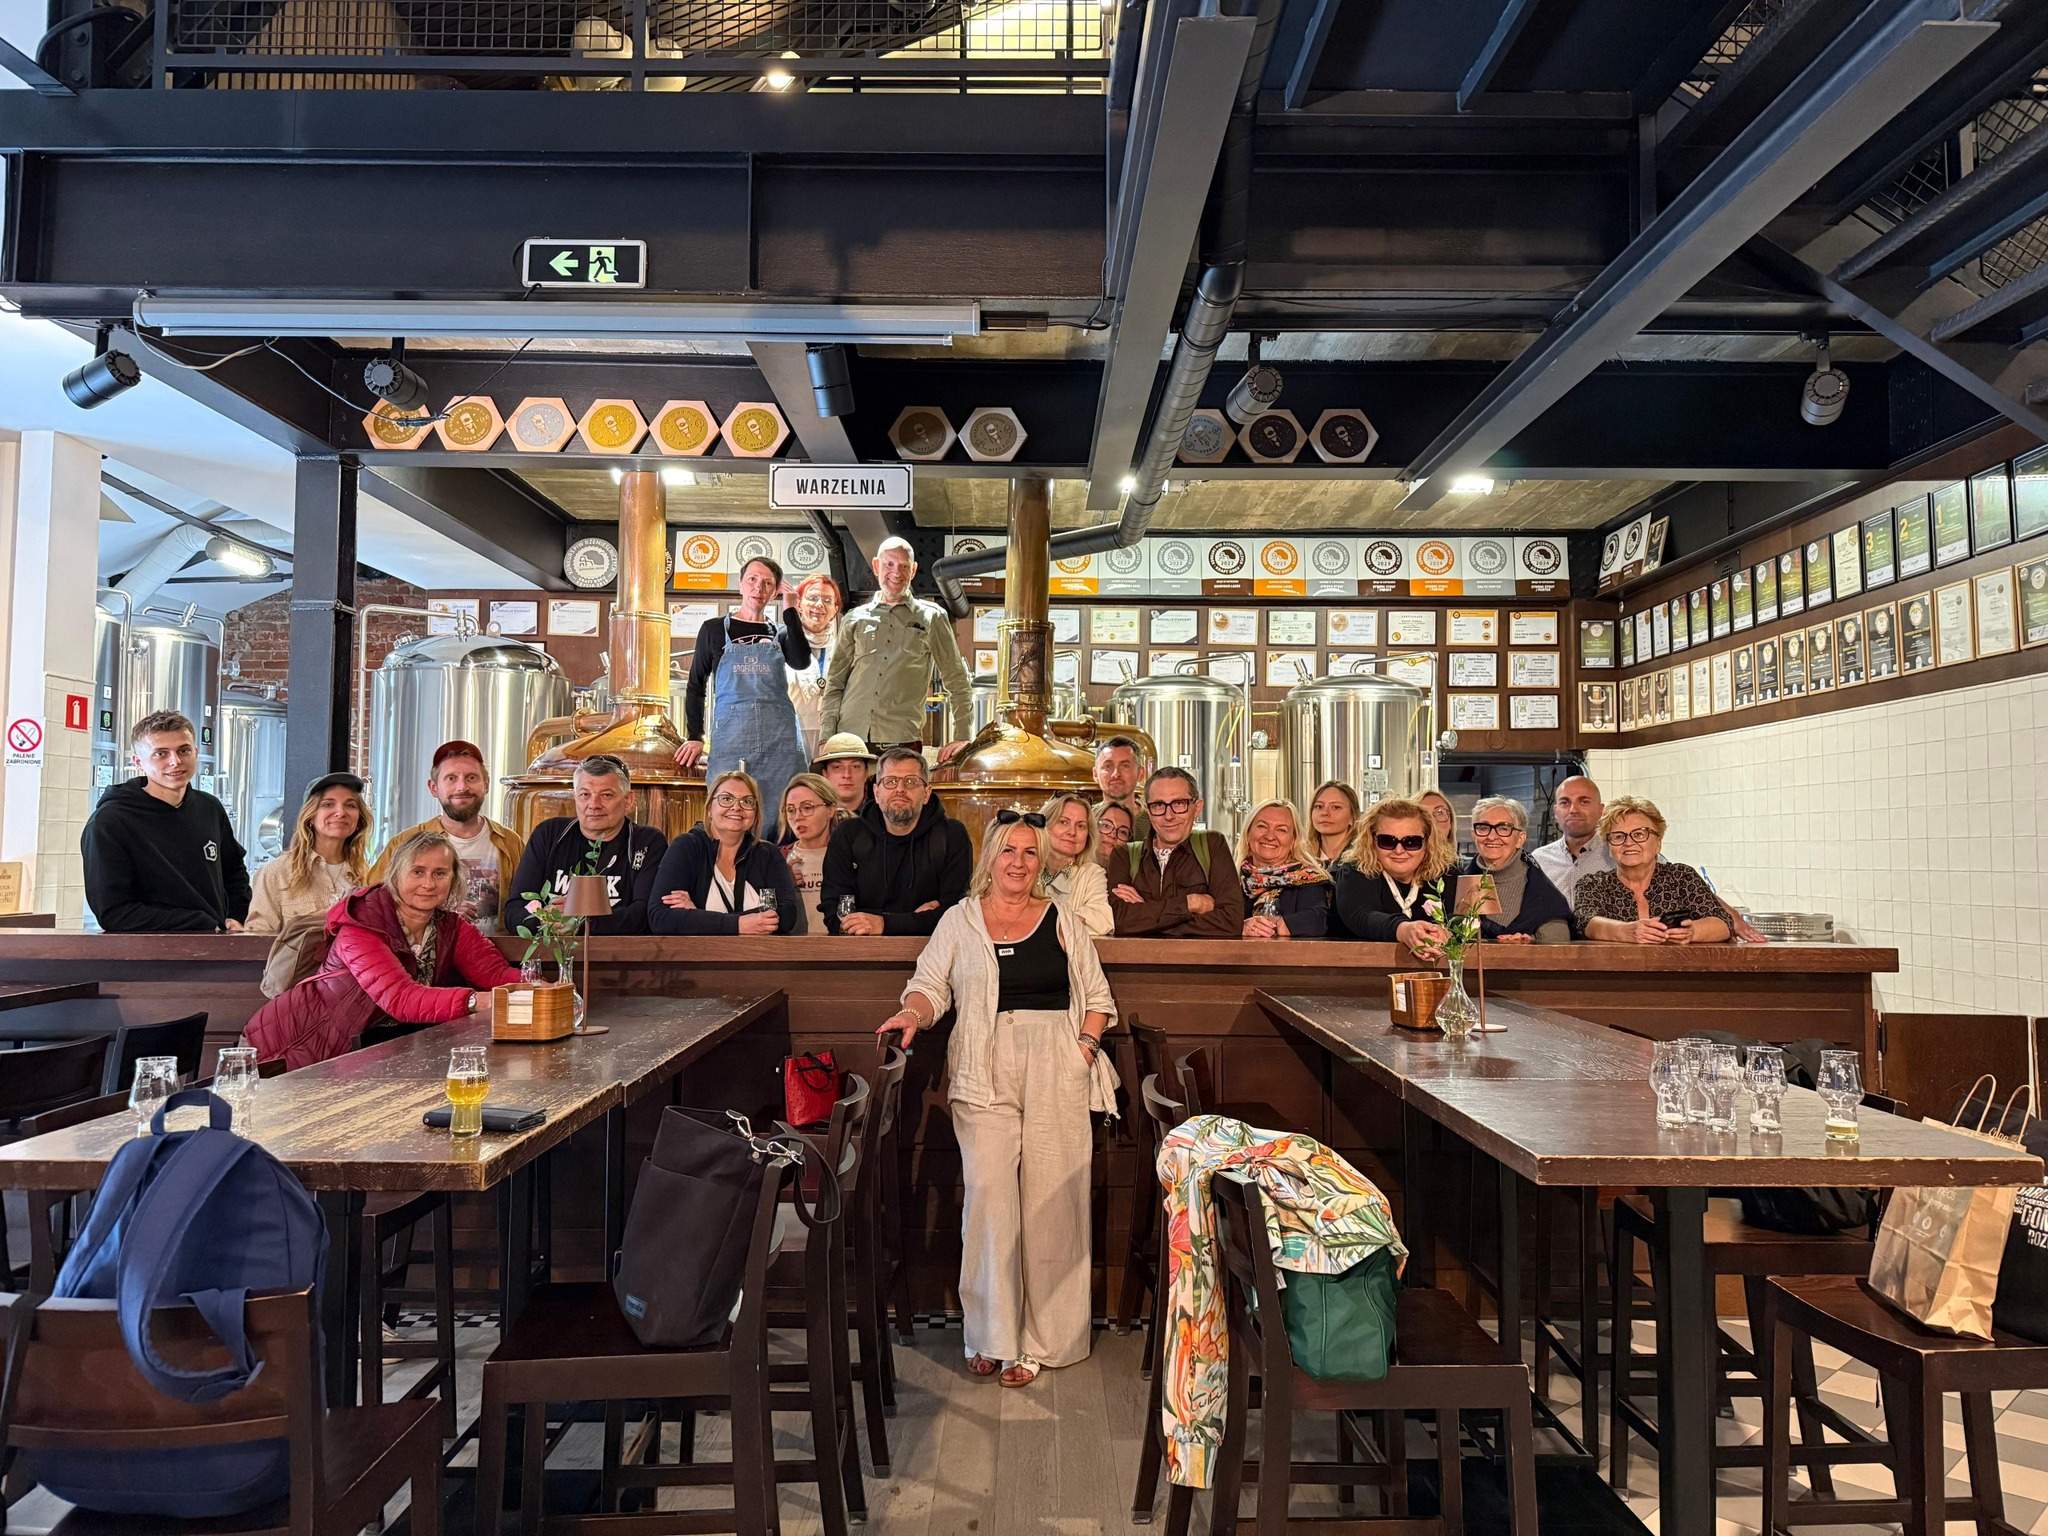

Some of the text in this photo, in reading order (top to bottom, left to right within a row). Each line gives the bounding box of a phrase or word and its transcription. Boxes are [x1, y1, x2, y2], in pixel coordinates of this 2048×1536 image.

[796, 479, 886, 494] WARZELNIA
[1900, 518, 1908, 538] 2
[1866, 532, 1874, 550] 3
